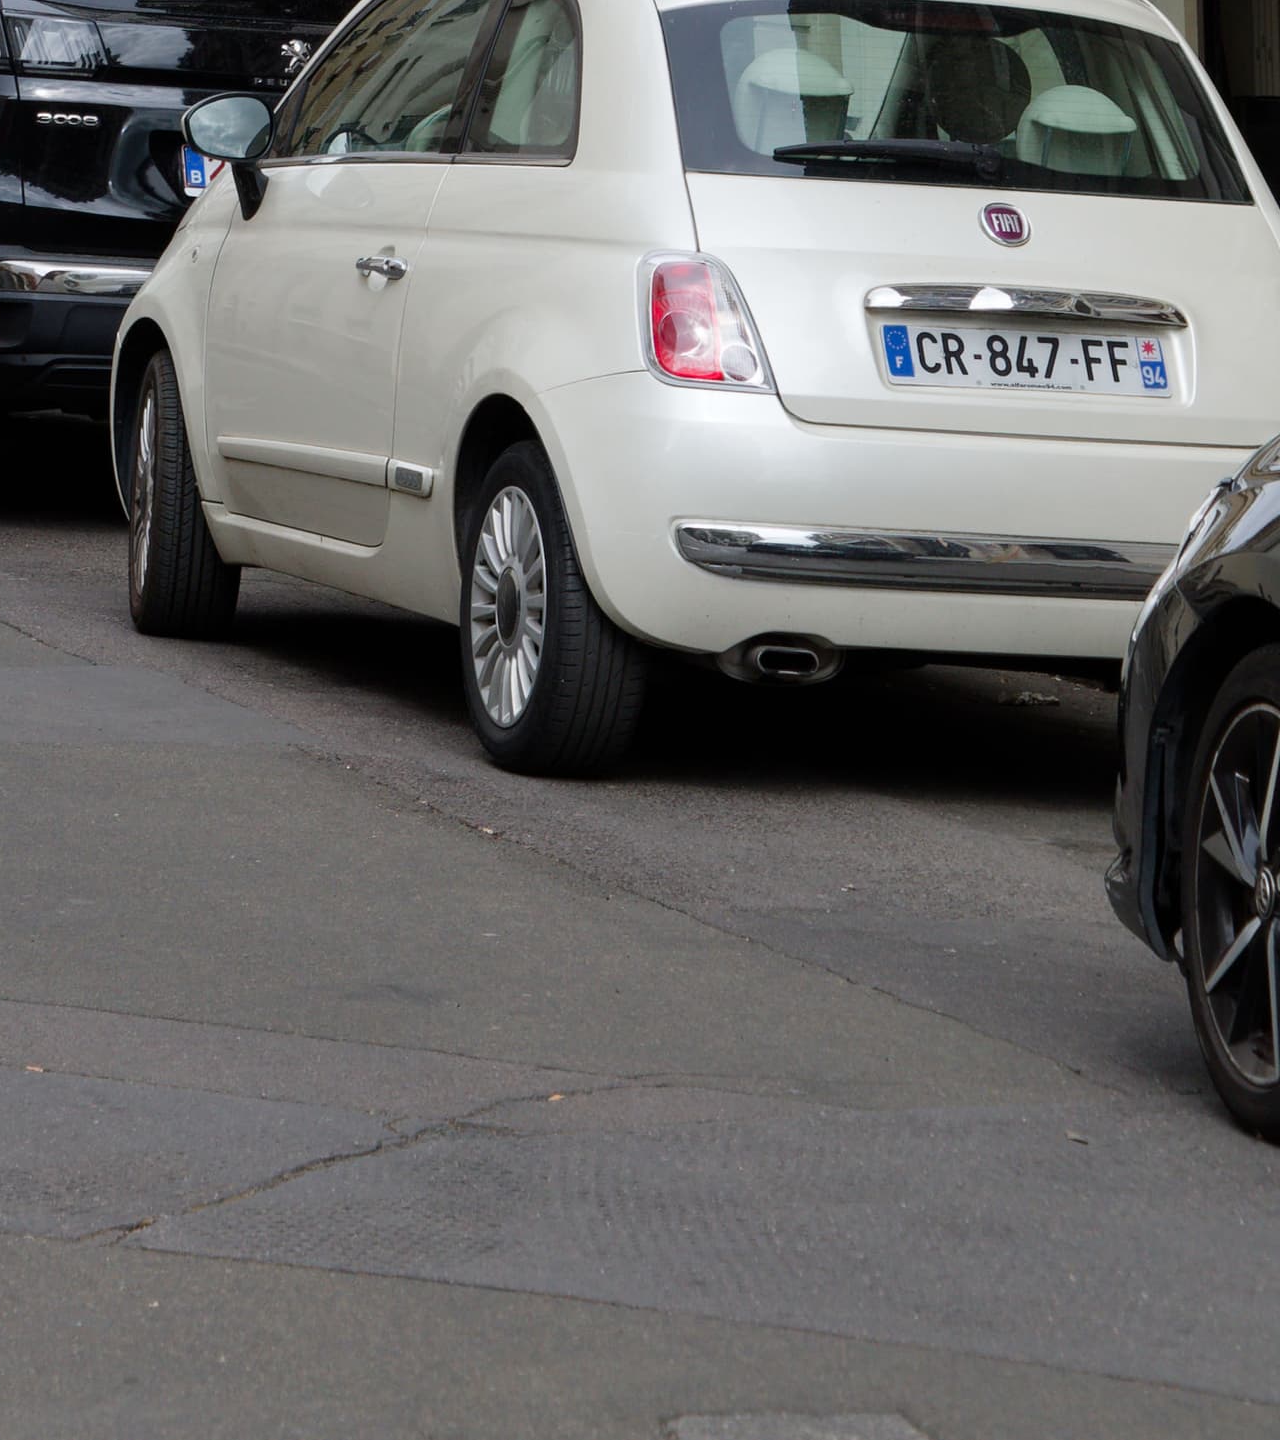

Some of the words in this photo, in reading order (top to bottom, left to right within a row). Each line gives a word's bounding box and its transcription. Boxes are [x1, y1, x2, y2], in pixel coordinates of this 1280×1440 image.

[36, 112, 100, 127] 3008
[190, 170, 203, 184] B
[991, 213, 1021, 233] FIAT
[895, 356, 904, 369] F
[916, 331, 1129, 382] CR-847-FF
[1142, 365, 1166, 386] 94
